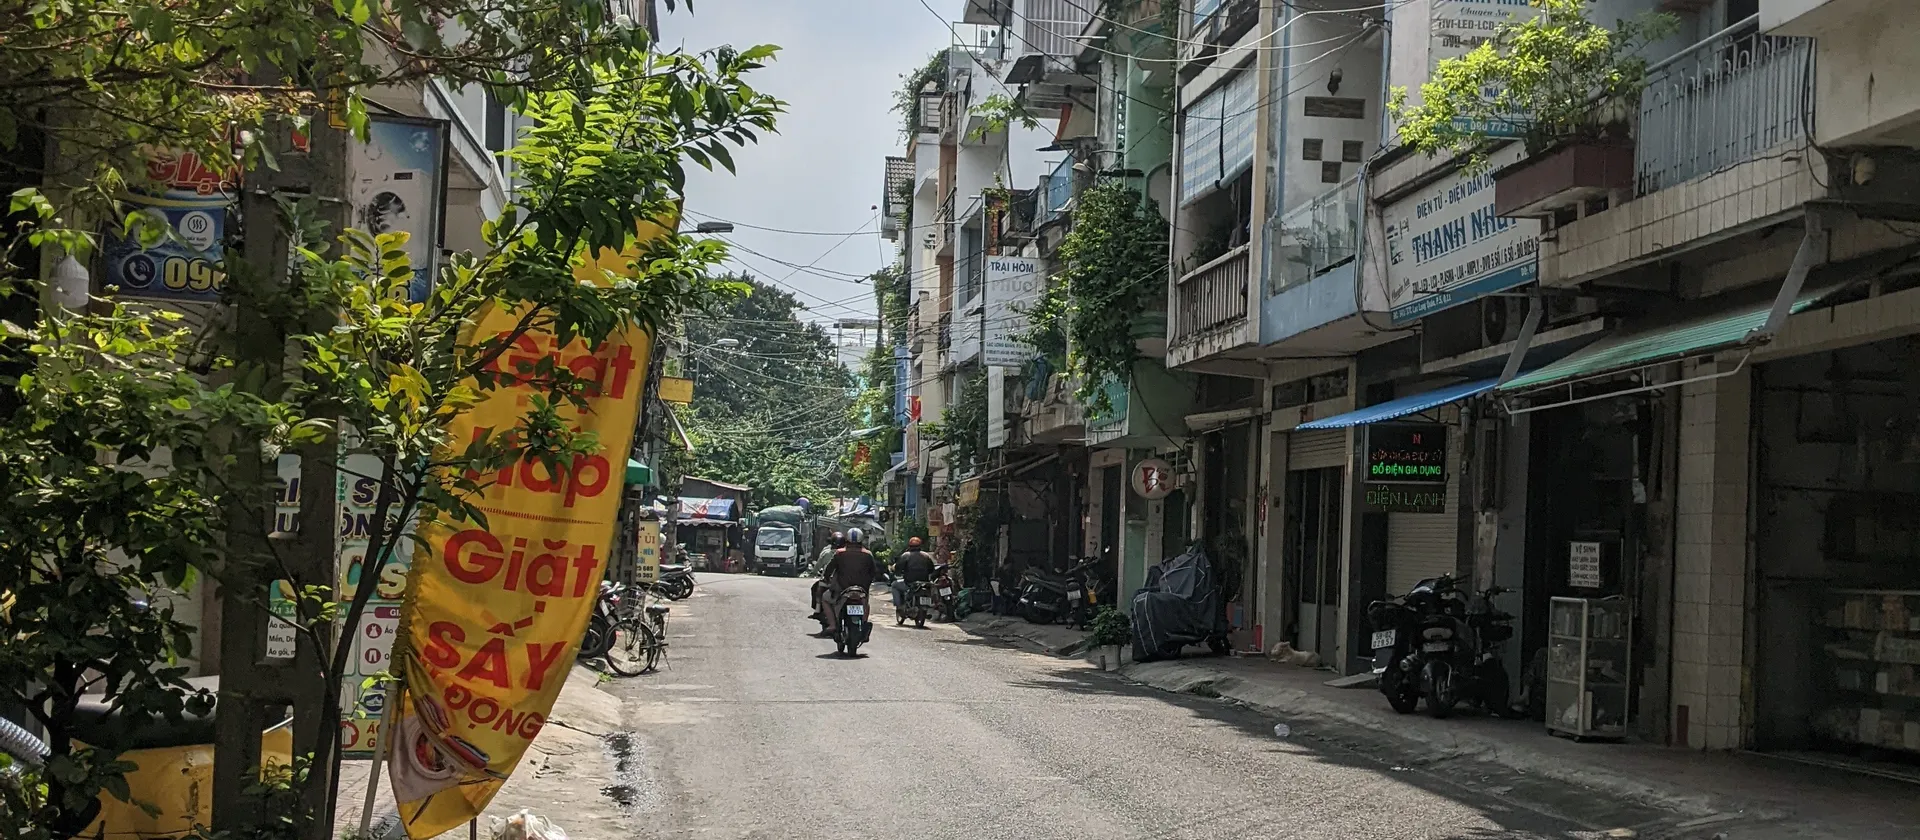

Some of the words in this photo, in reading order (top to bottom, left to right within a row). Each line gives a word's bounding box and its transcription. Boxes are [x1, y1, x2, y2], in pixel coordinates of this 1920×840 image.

[1448, 183, 1466, 204] ĐIỆN
[1411, 216, 1467, 267] THANH
[991, 261, 1010, 274] TRẠI
[1012, 259, 1034, 273] HÒM
[1385, 463, 1404, 476] ĐIỆN
[1405, 465, 1418, 475] GIA
[1419, 465, 1441, 477] DỤNG
[1404, 491, 1446, 512] LẠNH
[444, 528, 598, 613] Giặt
[424, 615, 567, 691] SẤY
